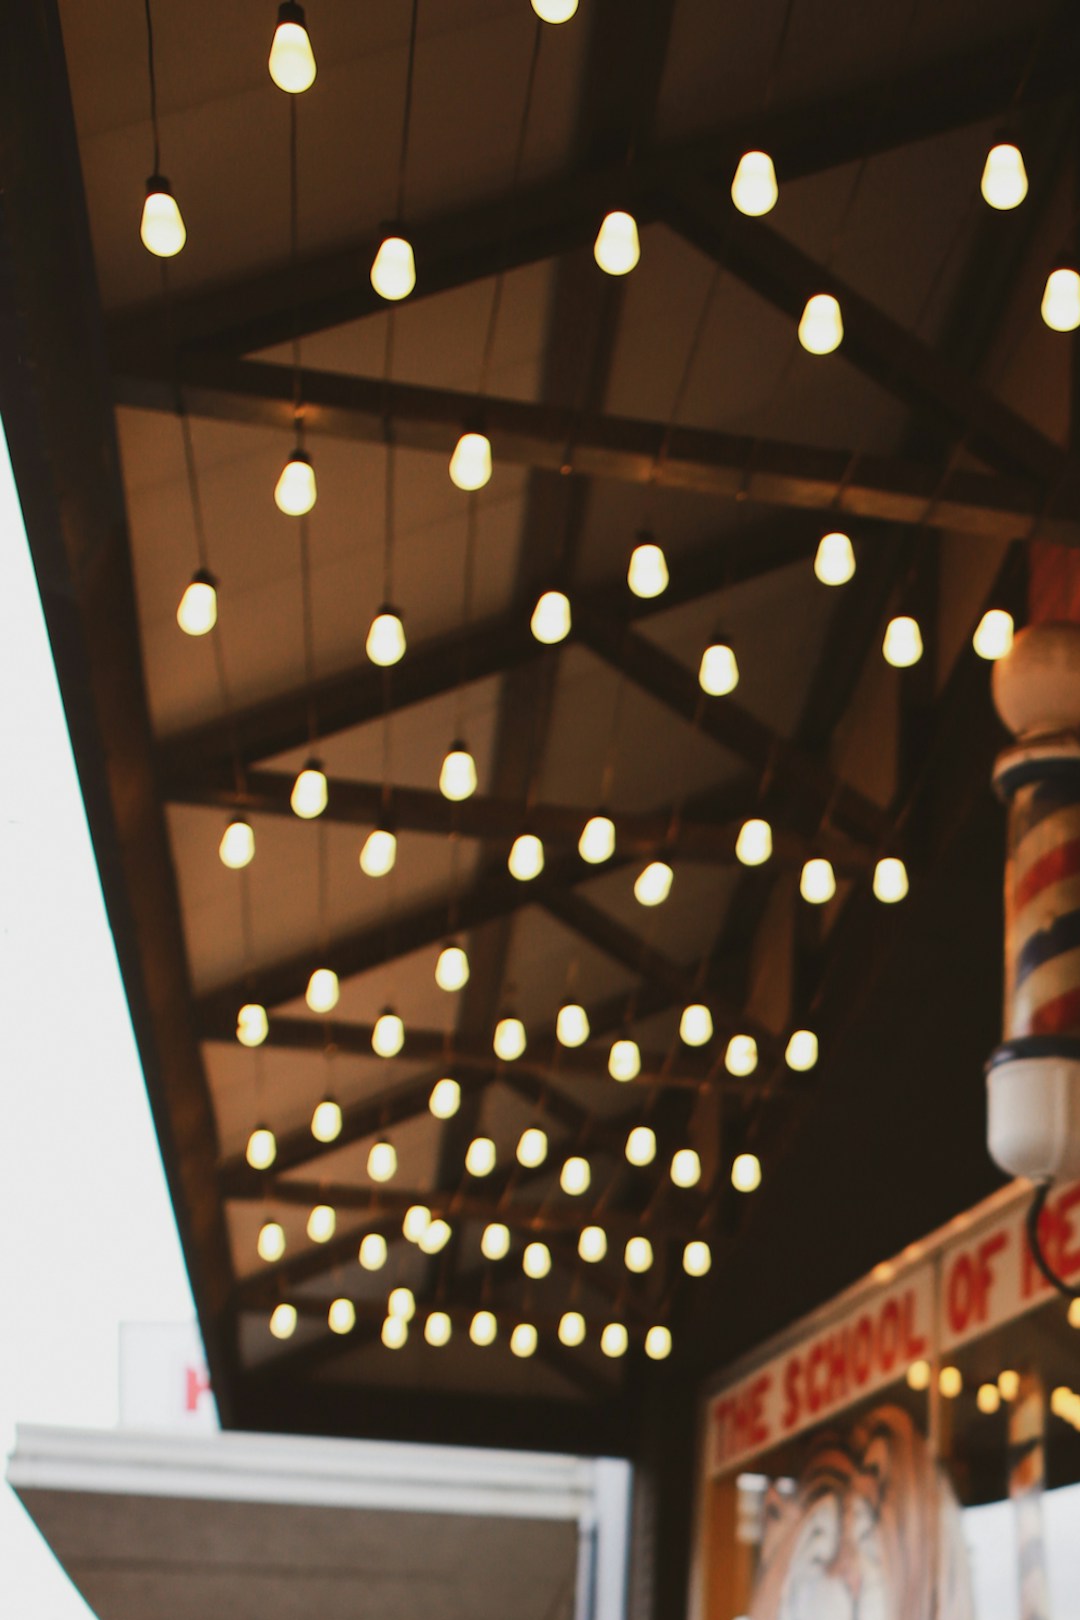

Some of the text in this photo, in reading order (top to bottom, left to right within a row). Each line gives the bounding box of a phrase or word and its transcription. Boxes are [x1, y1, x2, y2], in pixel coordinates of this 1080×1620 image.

[713, 1373, 772, 1463] THE
[781, 1287, 927, 1430] SCHOOL
[946, 1229, 1009, 1336] OF
